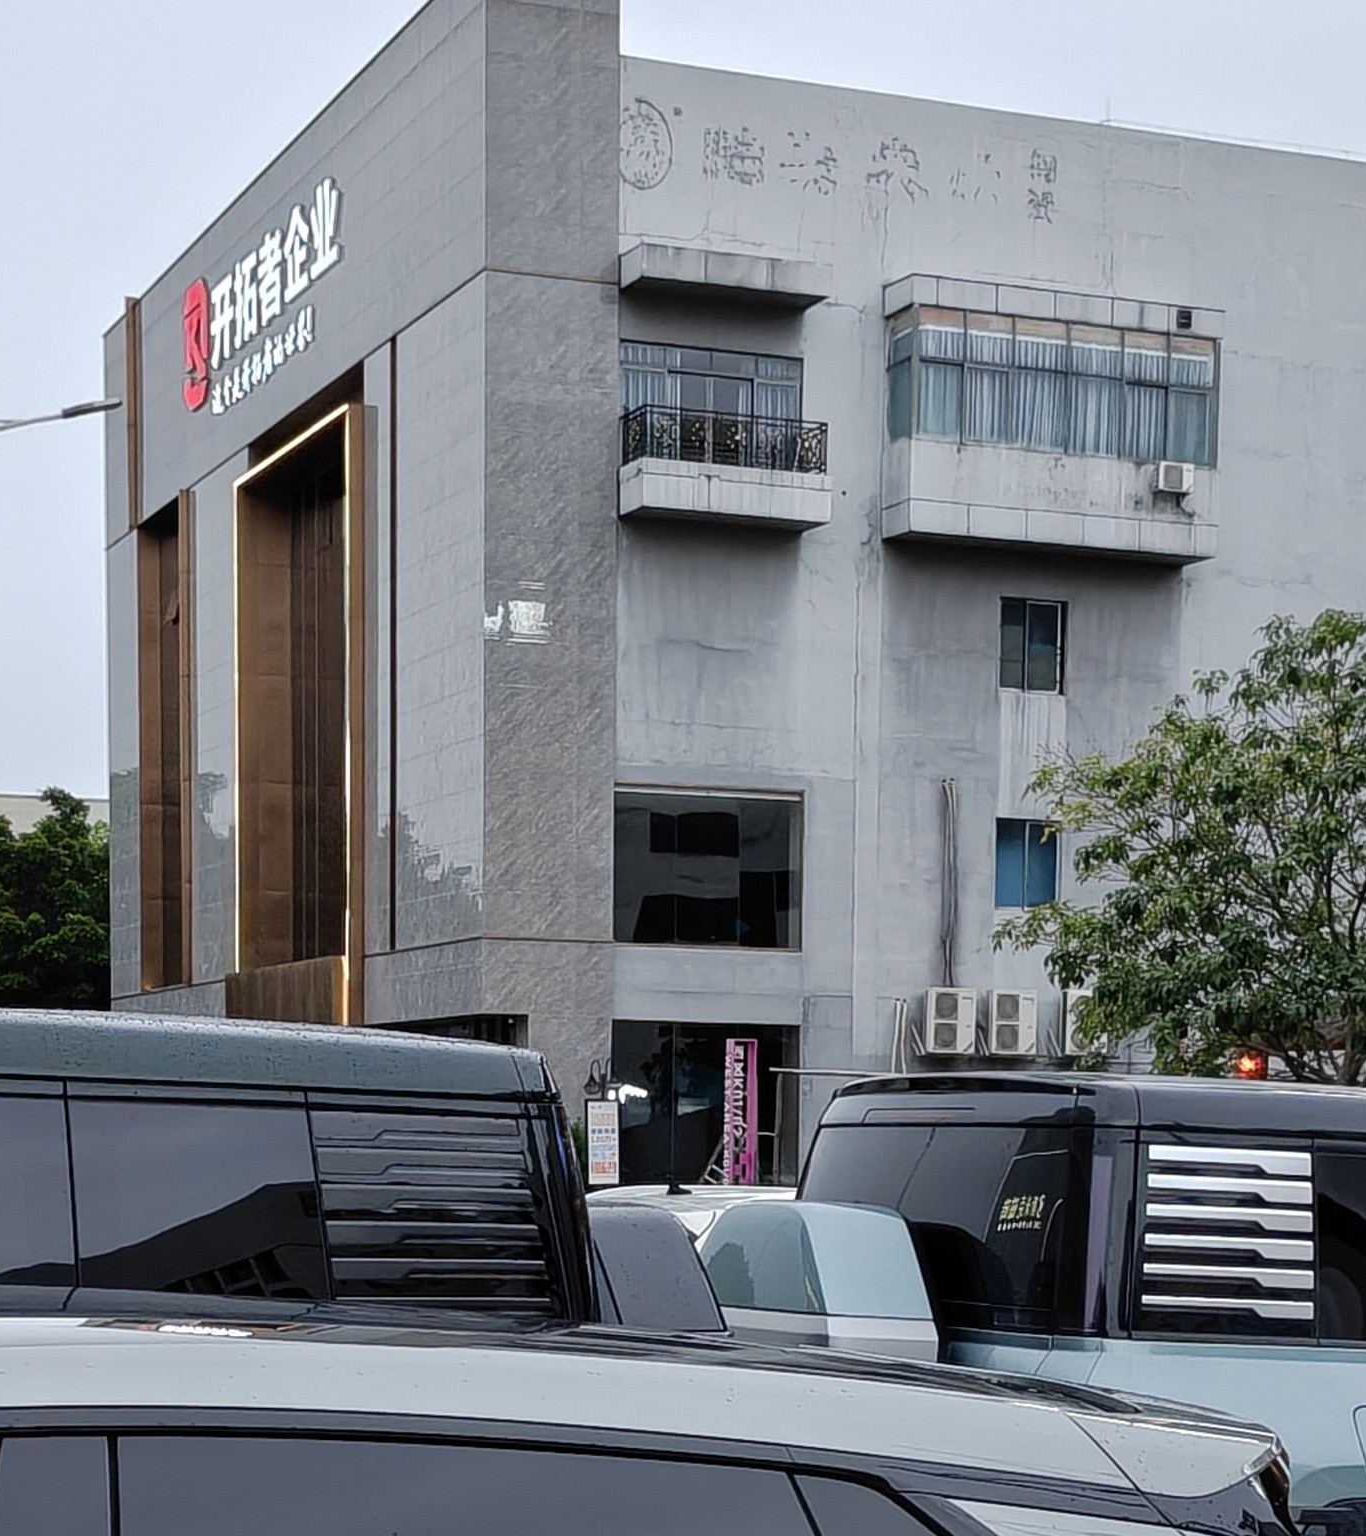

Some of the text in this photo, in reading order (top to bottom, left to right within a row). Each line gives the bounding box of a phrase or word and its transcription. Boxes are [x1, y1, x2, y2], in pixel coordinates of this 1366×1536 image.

[210, 177, 341, 371] 开拓者企业
